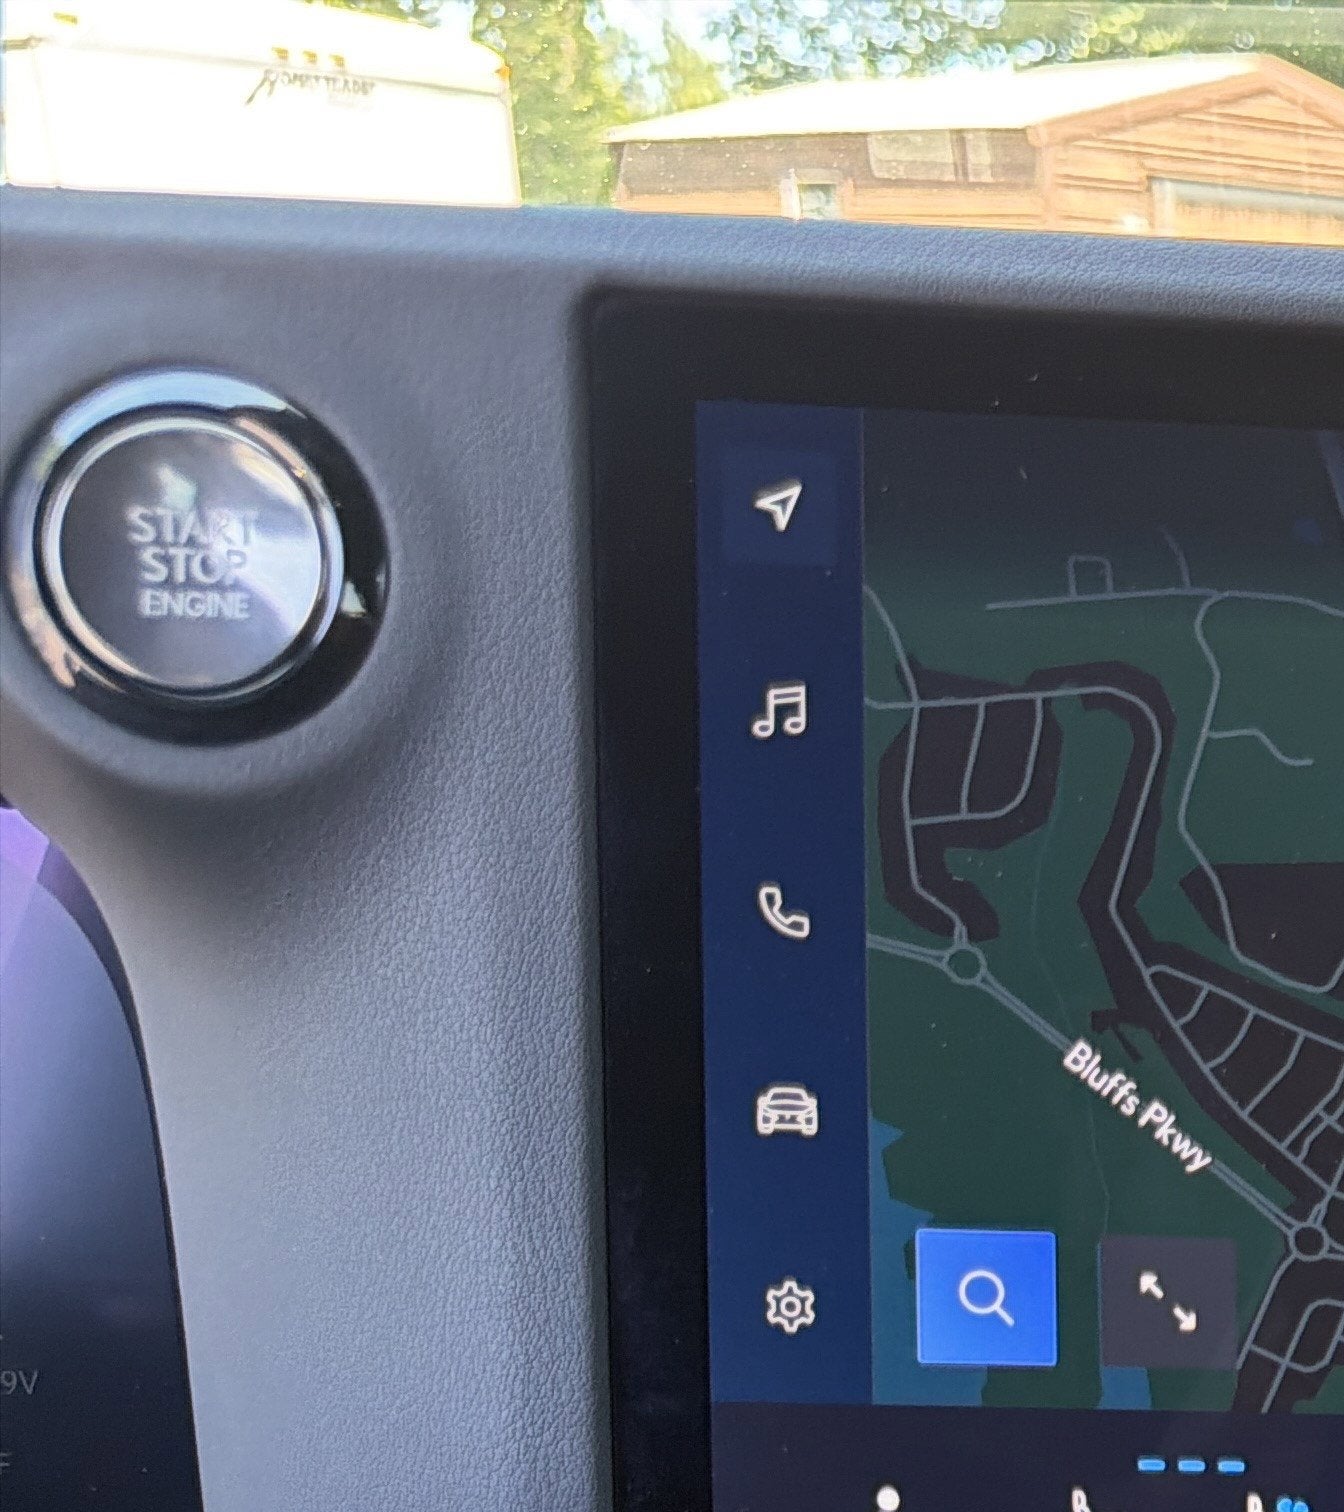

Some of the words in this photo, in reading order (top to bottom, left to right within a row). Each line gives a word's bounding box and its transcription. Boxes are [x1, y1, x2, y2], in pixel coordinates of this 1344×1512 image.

[127, 506, 258, 545] START
[138, 546, 248, 584] STOP
[138, 588, 251, 619] ENGINE
[1063, 1038, 1142, 1116] Bluffs
[1139, 1101, 1212, 1173] Pkwy
